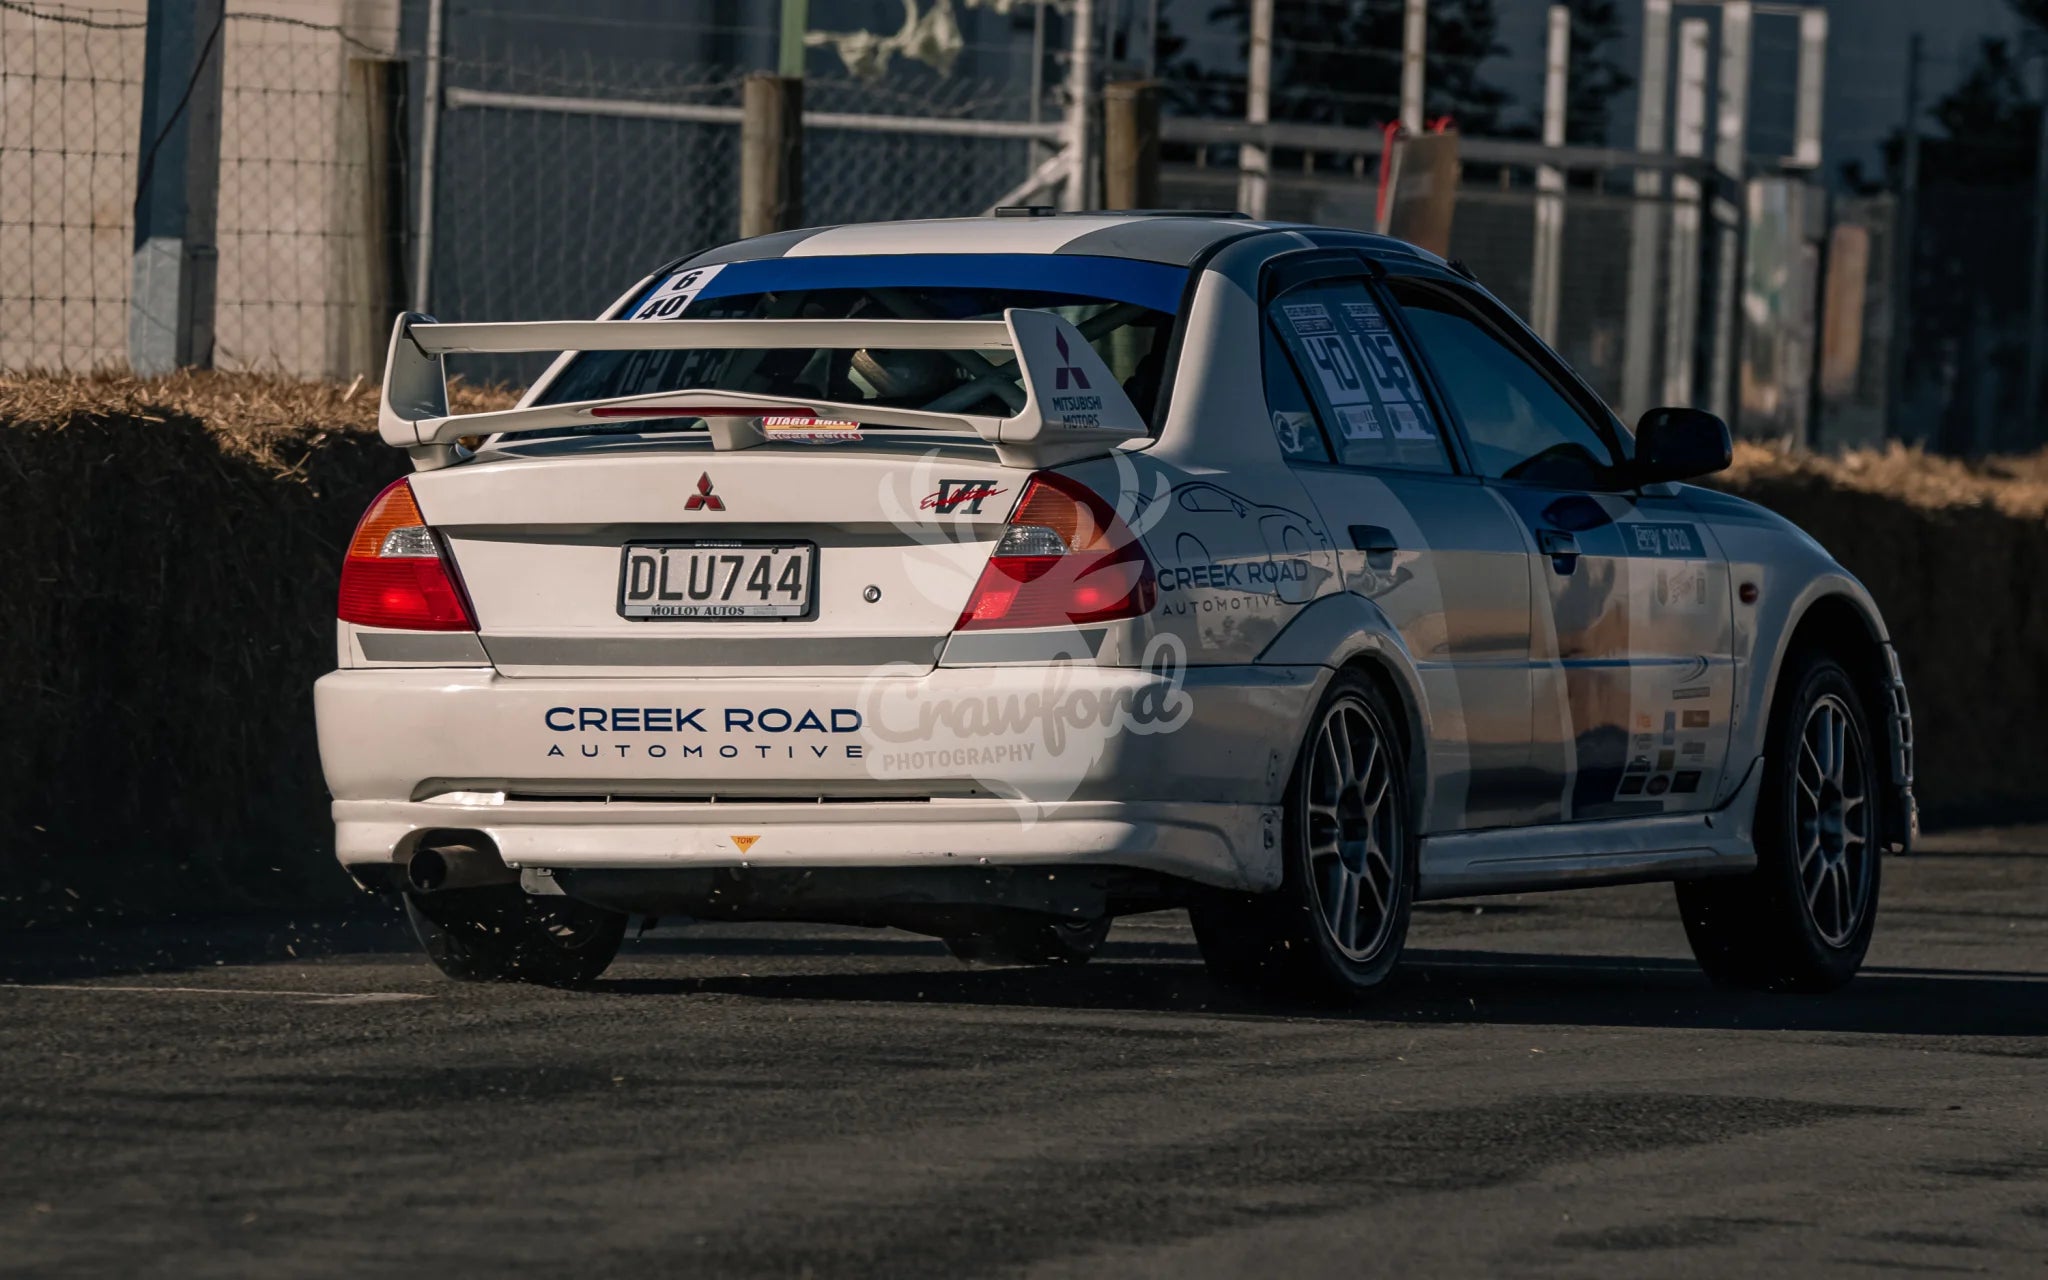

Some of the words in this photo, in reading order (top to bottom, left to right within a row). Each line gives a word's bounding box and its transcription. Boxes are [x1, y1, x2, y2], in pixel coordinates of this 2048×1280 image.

[672, 270, 703, 290] 6
[636, 295, 688, 319] 40
[1307, 337, 1360, 391] 40
[1052, 396, 1102, 411] MITSUBISHI
[1063, 415, 1100, 429] MOTORS
[628, 555, 802, 601] DLU744
[1157, 563, 1242, 592] CREEK
[1248, 560, 1309, 583] ROAD
[651, 606, 700, 616] MOLLOY
[704, 606, 744, 616] AUTOS
[1162, 595, 1282, 616] AUTOMOTIVE
[545, 706, 708, 732] CREEK
[724, 708, 863, 733] ROAD
[547, 744, 863, 758] AUTOMOTIVE
